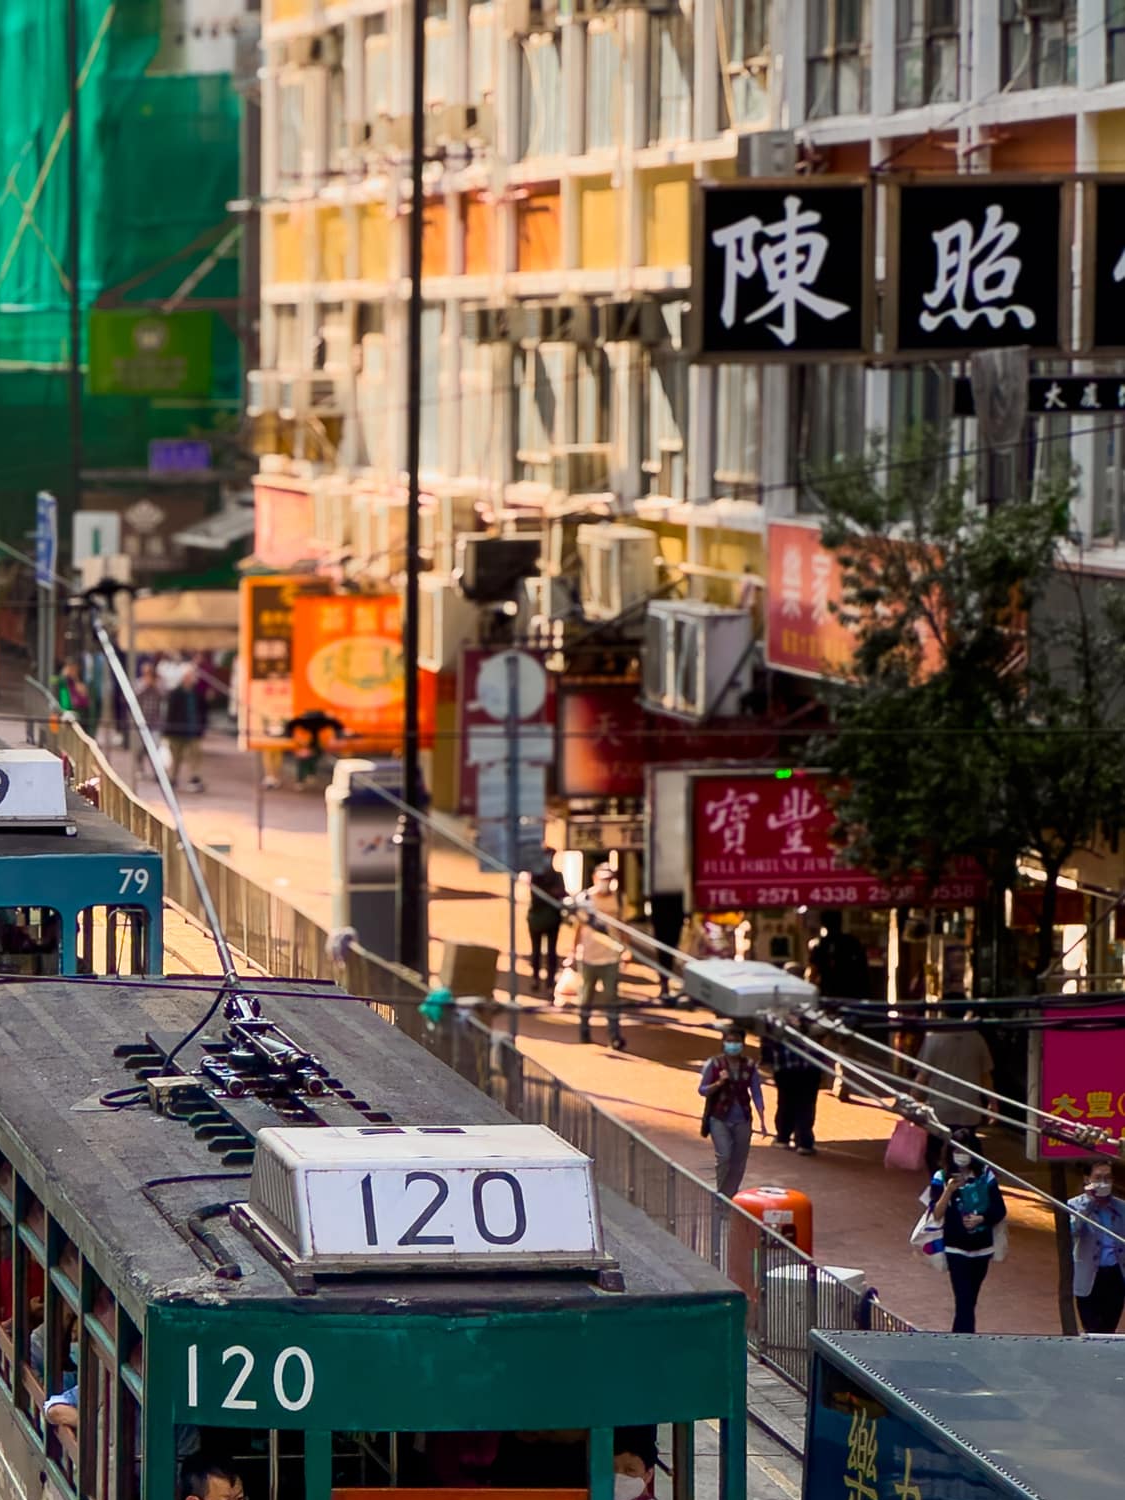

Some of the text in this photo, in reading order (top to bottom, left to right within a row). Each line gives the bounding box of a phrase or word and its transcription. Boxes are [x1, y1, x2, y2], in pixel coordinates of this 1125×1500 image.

[1044, 381, 1125, 409] 大廈
[118, 868, 150, 895] 79
[757, 887, 800, 904] 2571
[810, 886, 858, 902] 4338
[360, 1170, 528, 1247] 120
[187, 1344, 315, 1412] 120
